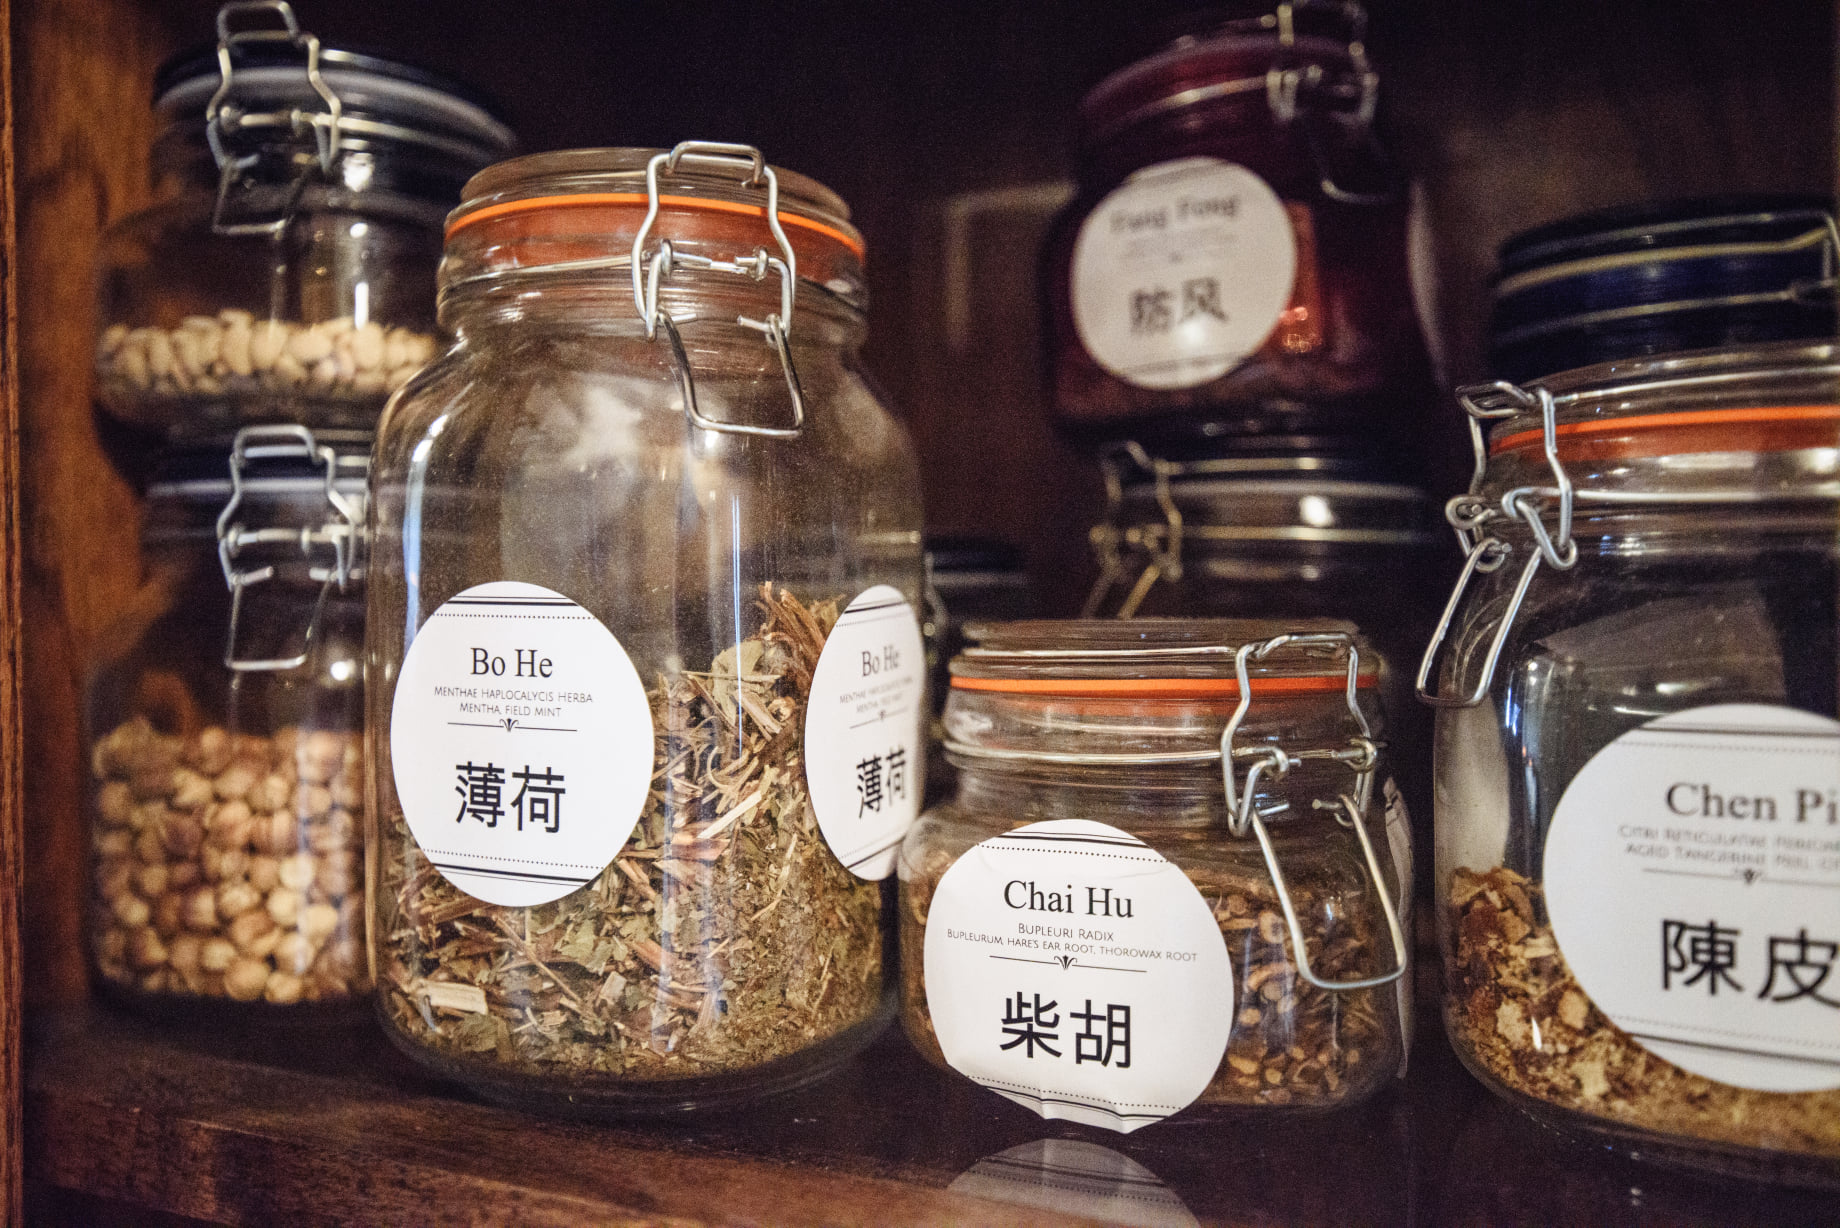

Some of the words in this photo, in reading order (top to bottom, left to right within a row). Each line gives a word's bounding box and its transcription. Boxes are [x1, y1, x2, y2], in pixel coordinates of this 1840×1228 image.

[470, 647, 507, 676] Bo
[514, 649, 553, 678] He
[861, 650, 880, 677] Bo
[883, 645, 901, 672] He
[434, 686, 478, 698] MENTHAE
[481, 688, 554, 702] HAPLOCALYCIS
[558, 691, 593, 703] HERBA
[505, 705, 531, 716] FIELD
[534, 707, 562, 717] MINT
[455, 761, 566, 833] 薄荷
[856, 744, 906, 819] 薄荷
[1665, 782, 1777, 821] Chen
[1796, 788, 1839, 825] Pi
[1004, 880, 1075, 913] Chai
[1085, 887, 1134, 918] Hu
[1008, 937, 1039, 949] HARE'S
[1043, 941, 1061, 951] EAR
[1100, 946, 1162, 959] THOROWAX
[1166, 951, 1197, 962] ROOT
[1018, 923, 1073, 938] BUPLEURI
[1079, 928, 1114, 941] RADIX
[1661, 918, 1840, 1009] 陳皮
[999, 991, 1131, 1068] 柴胡
